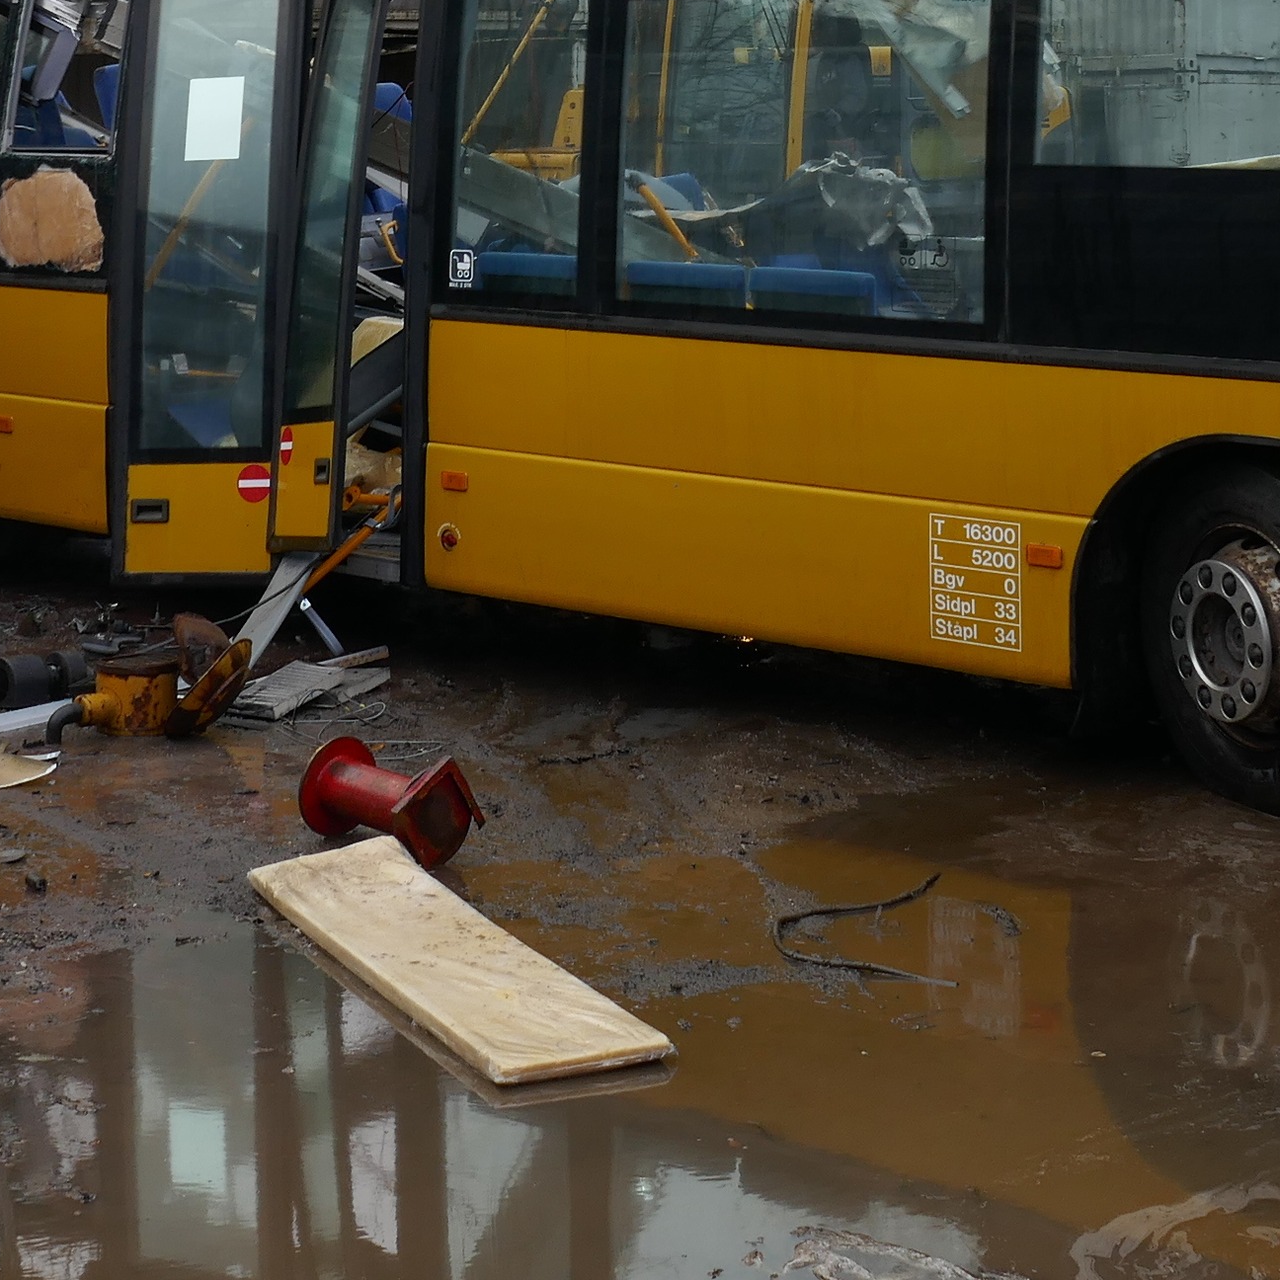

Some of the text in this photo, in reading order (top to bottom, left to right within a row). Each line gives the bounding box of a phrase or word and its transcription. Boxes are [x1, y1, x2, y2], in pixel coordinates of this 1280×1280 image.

[933, 519, 1016, 545] T 16300
[933, 543, 1016, 569] L 5200
[933, 568, 1016, 595] Bgv 0
[934, 594, 1017, 620] Sidpl 33
[994, 627, 1017, 646] 34
